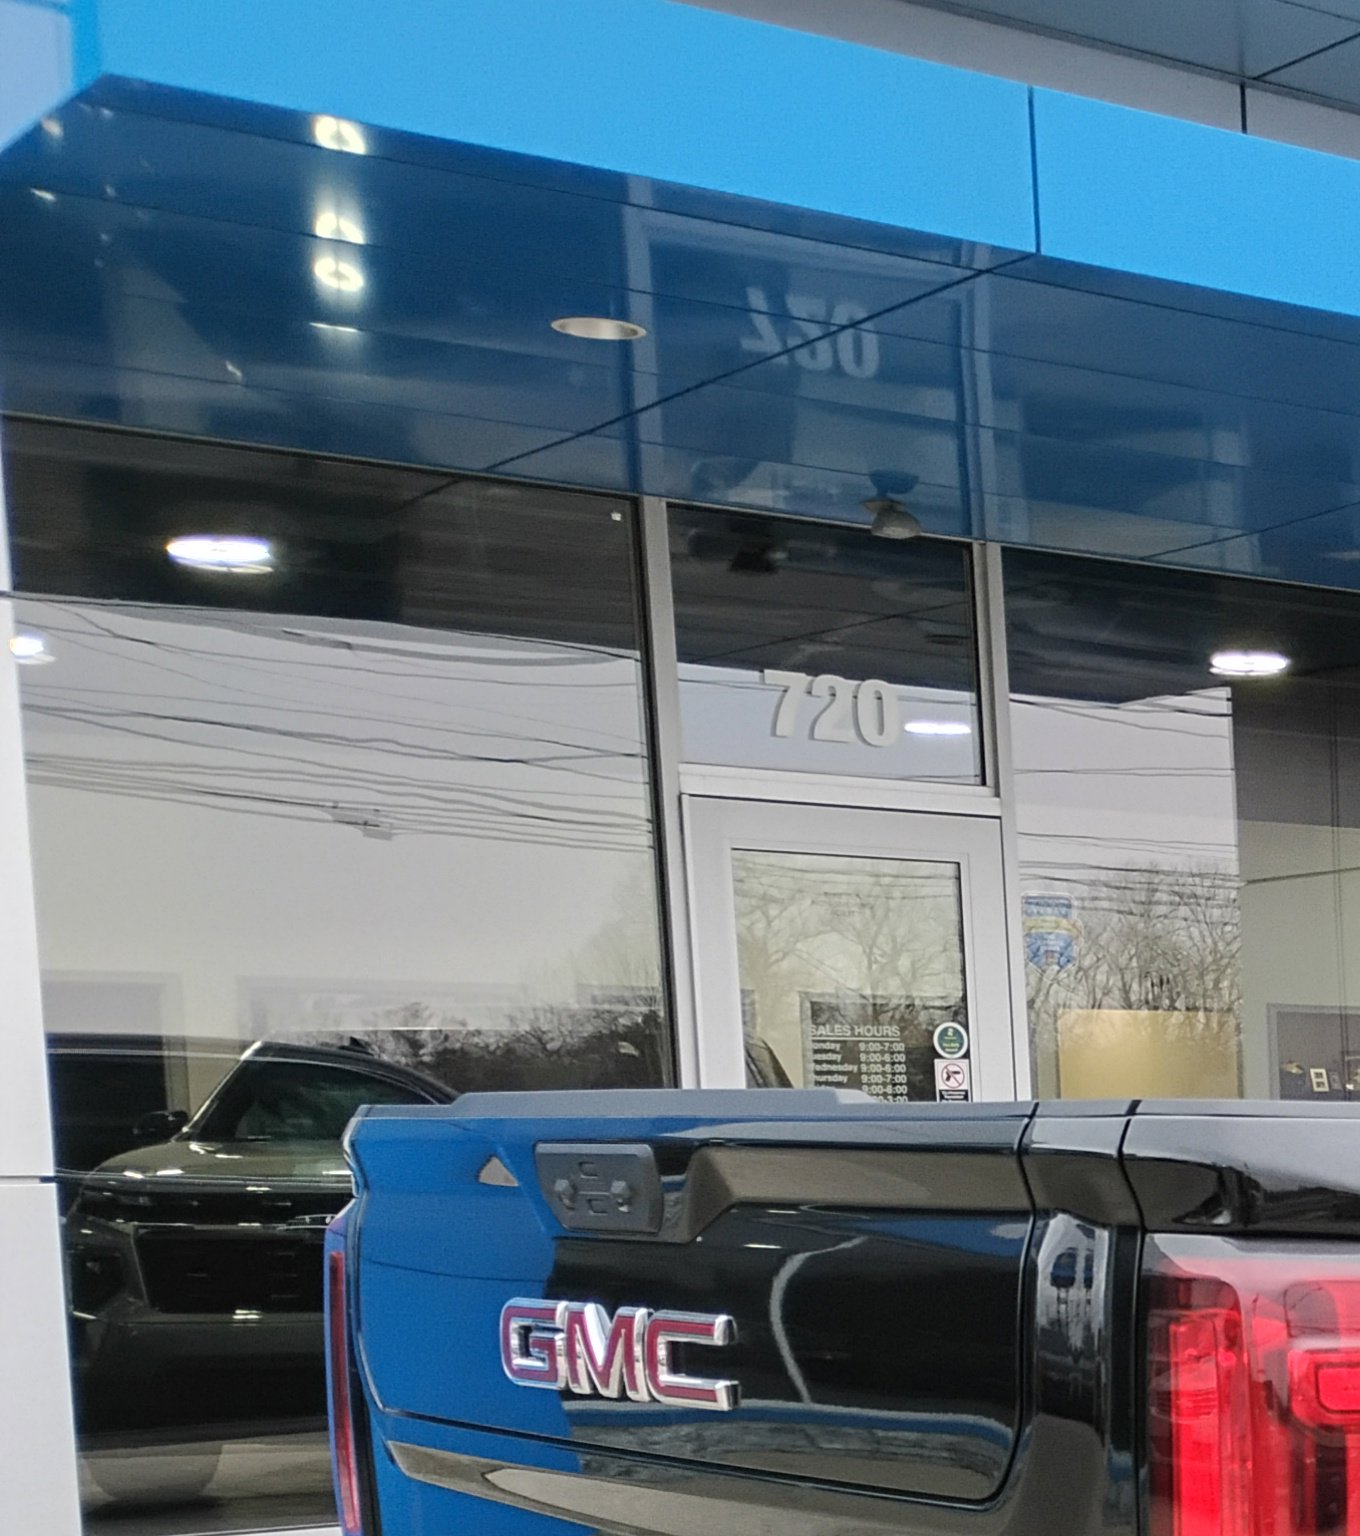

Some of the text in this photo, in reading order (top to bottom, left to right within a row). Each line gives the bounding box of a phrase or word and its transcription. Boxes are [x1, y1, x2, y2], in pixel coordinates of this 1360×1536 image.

[760, 669, 899, 747] 720
[809, 1024, 900, 1037] SALES HOURS
[810, 1042, 905, 1052] onday 9:00-7:00
[811, 1053, 842, 1063] uesday
[813, 1063, 858, 1073] ednesday
[812, 1074, 908, 1083] hursday 9:00-7:00
[500, 1297, 741, 1412] GMC
